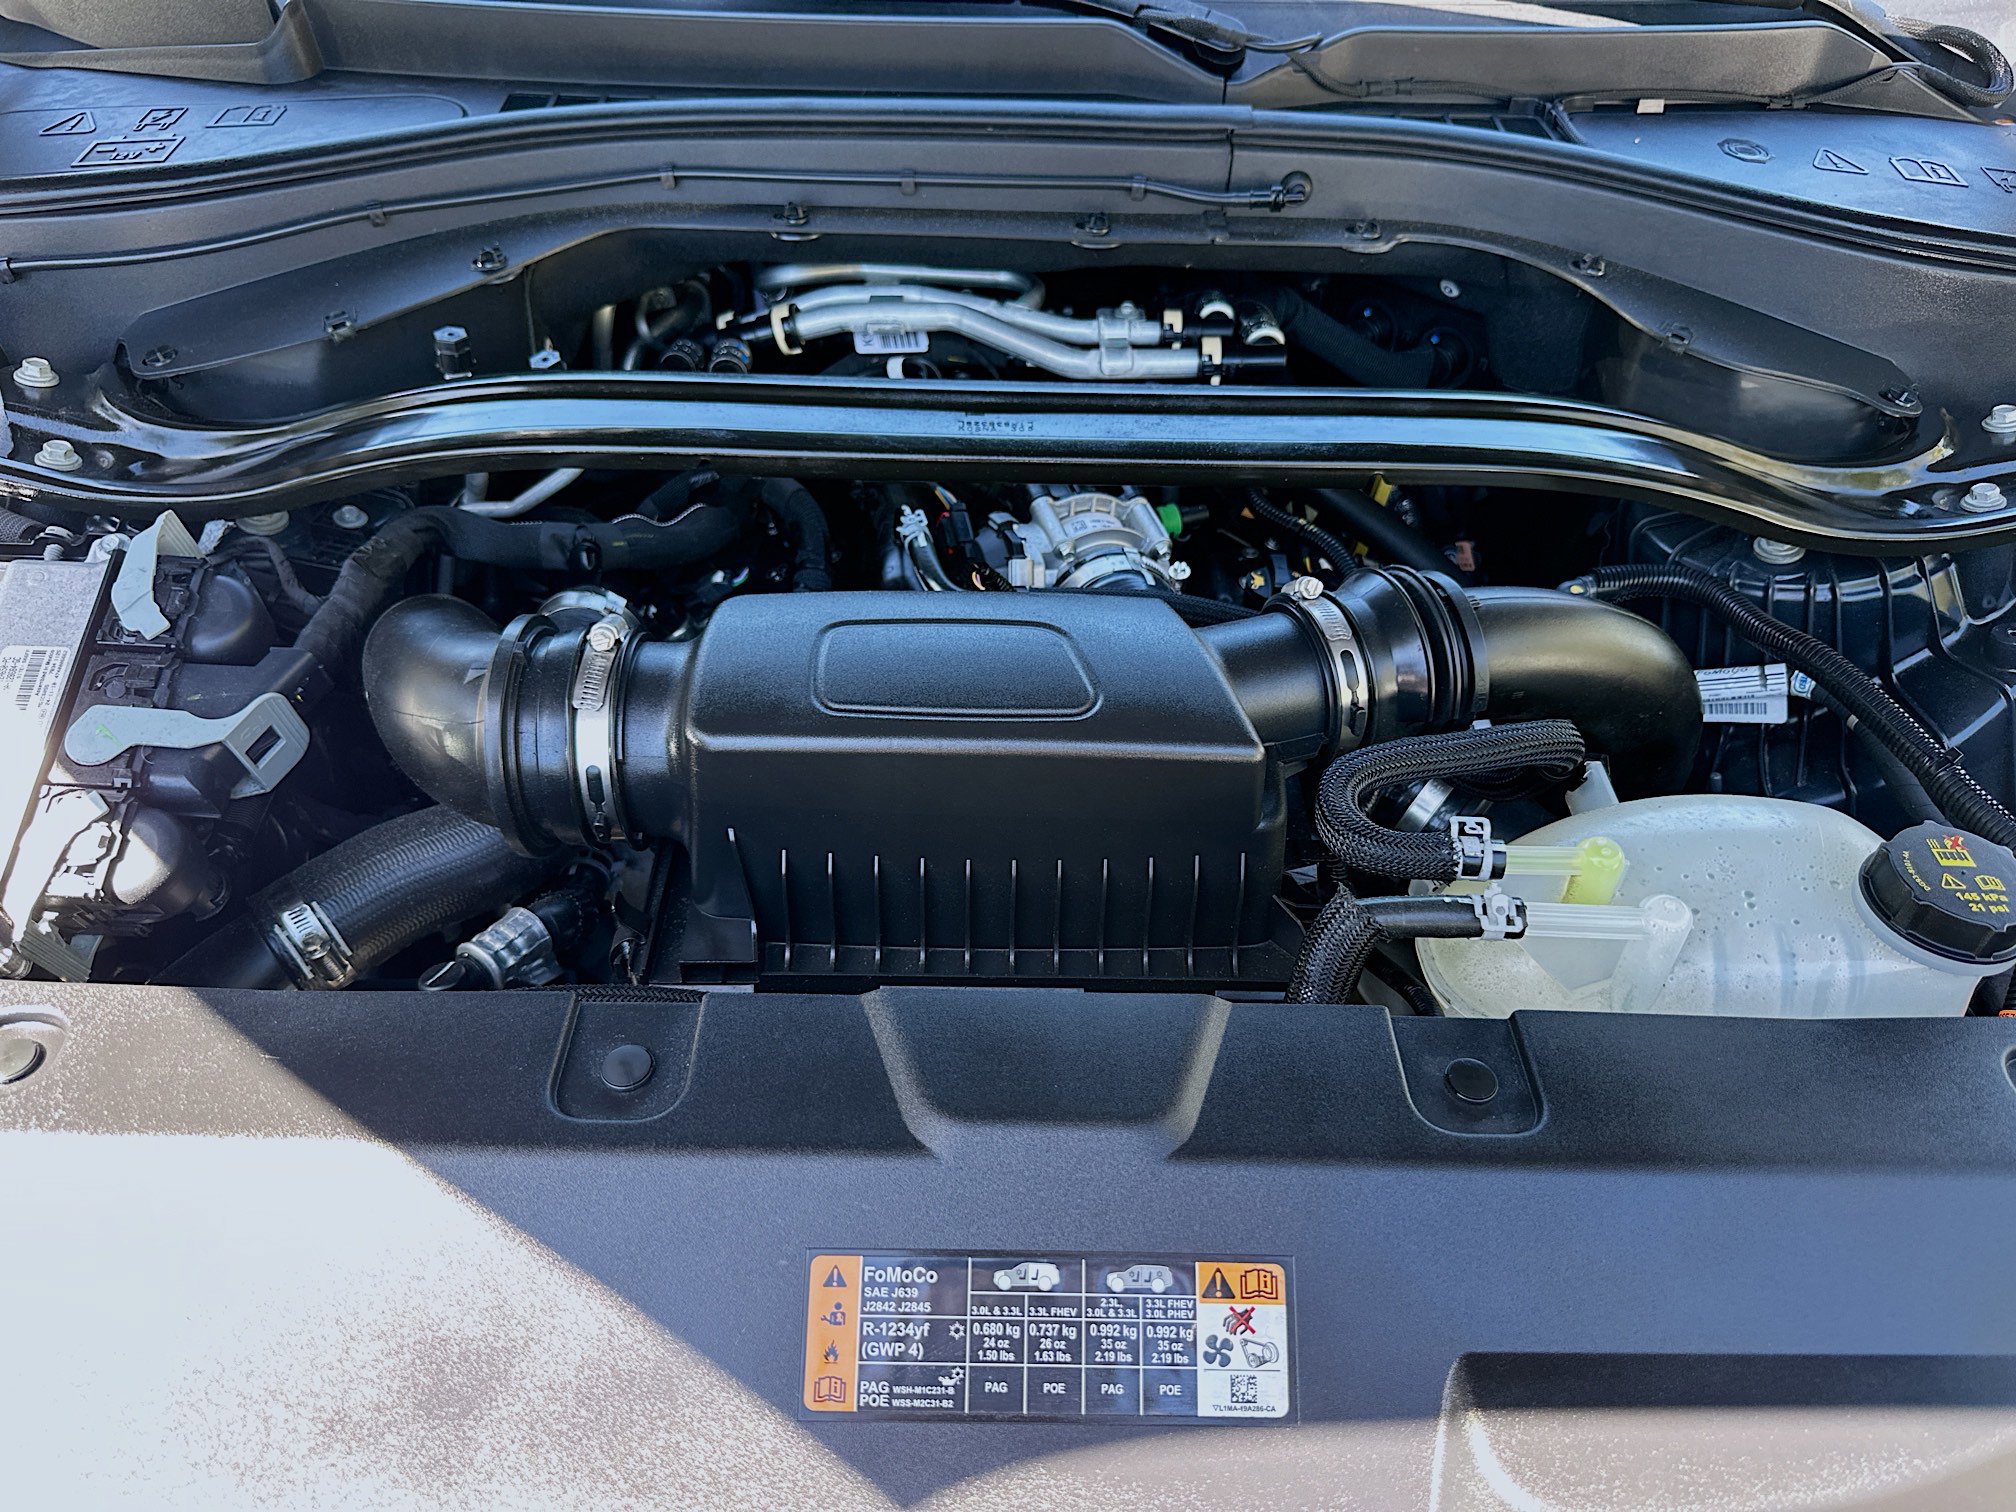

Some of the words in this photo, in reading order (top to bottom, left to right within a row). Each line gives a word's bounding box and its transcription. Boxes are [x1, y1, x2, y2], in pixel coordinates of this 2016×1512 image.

[1955, 892, 1980, 901] 145
[1981, 893, 2009, 902] kPa
[1969, 903, 1986, 912] 21
[1989, 904, 2010, 914] psi
[864, 1266, 938, 1284] FoMoCo
[864, 1287, 888, 1298] SAE
[891, 1287, 918, 1299] J639
[863, 1301, 895, 1312] J2842
[898, 1301, 931, 1313] J2845
[1100, 1298, 1123, 1308] 2.3L,
[1145, 1299, 1165, 1308] 3.3L
[1167, 1299, 1194, 1309] FHEV
[971, 1306, 991, 1316] 3.0L
[993, 1306, 1001, 1316] &
[1002, 1306, 1023, 1316] 3.3L
[1028, 1307, 1049, 1316] 3.3L
[1051, 1307, 1078, 1317] FHEV
[1086, 1308, 1106, 1317] 3.0L
[1108, 1308, 1116, 1317] &
[1117, 1308, 1138, 1318] 3.3L
[1145, 1309, 1166, 1318] 3.0L
[1168, 1309, 1194, 1319] PHEV
[863, 1322, 930, 1340] R-1234yf
[972, 1323, 1003, 1335] 0.680
[1006, 1323, 1020, 1339] kg
[1029, 1324, 1060, 1336] 0.737
[1062, 1324, 1077, 1340] kg
[1090, 1324, 1120, 1336] 0.992
[1123, 1324, 1138, 1340] kg
[1147, 1325, 1177, 1337] 0.992
[1179, 1325, 1194, 1341] kg
[983, 1338, 996, 1348] 24
[997, 1340, 1010, 1348] oz
[1039, 1339, 1052, 1348] 26
[1054, 1341, 1066, 1349] oz
[1100, 1340, 1113, 1349] 35
[1115, 1342, 1127, 1350] oz
[1157, 1341, 1170, 1350] 35
[1171, 1343, 1183, 1351] oz
[861, 1342, 905, 1360] (GWP
[908, 1342, 924, 1360] 4)
[977, 1351, 997, 1361] 1.50
[999, 1350, 1015, 1361] lbs
[1034, 1352, 1054, 1362] 1.63
[1056, 1352, 1072, 1362] lbs
[1094, 1352, 1114, 1362] 2.19
[1117, 1352, 1132, 1362] lbs
[1151, 1353, 1172, 1363] 2.19
[1174, 1353, 1189, 1364] lbs
[860, 1381, 890, 1394] PAG
[892, 1385, 955, 1395] WSH-M1C231-B
[984, 1381, 1008, 1393] PAG
[1043, 1382, 1066, 1394] POE
[1101, 1383, 1124, 1394] PAG
[1159, 1384, 1182, 1395] POE
[860, 1394, 890, 1407] POE
[892, 1398, 954, 1408] WSS-M2C31-B2
